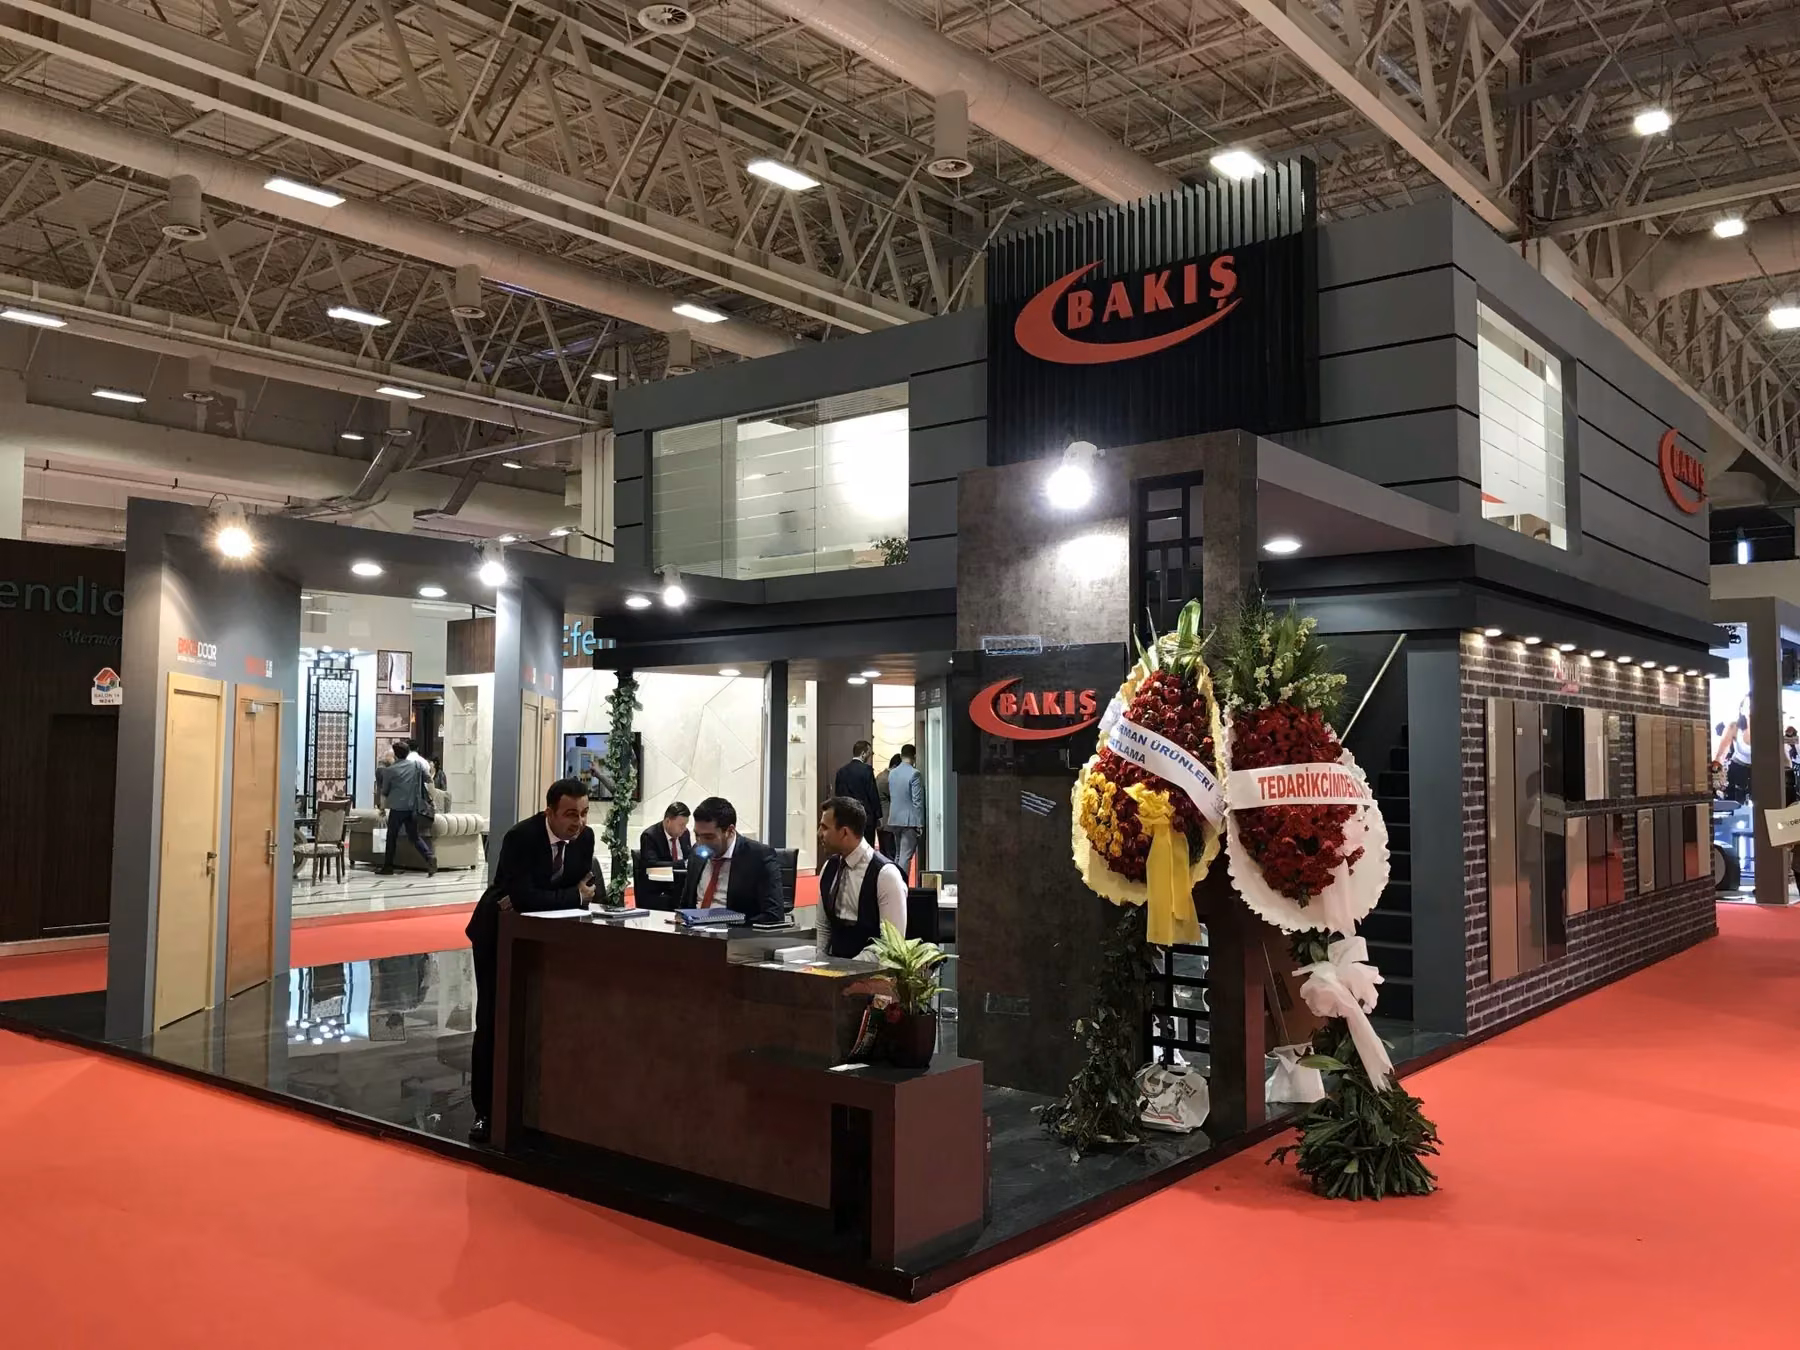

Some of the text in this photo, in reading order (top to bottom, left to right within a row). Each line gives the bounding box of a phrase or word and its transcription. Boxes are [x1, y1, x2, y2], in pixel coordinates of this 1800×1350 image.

[1067, 255, 1238, 330] BAKIŞ
[1000, 688, 1097, 721] BAKIŞ
[1117, 724, 1215, 792] RMAN ÜRÜNLERİ
